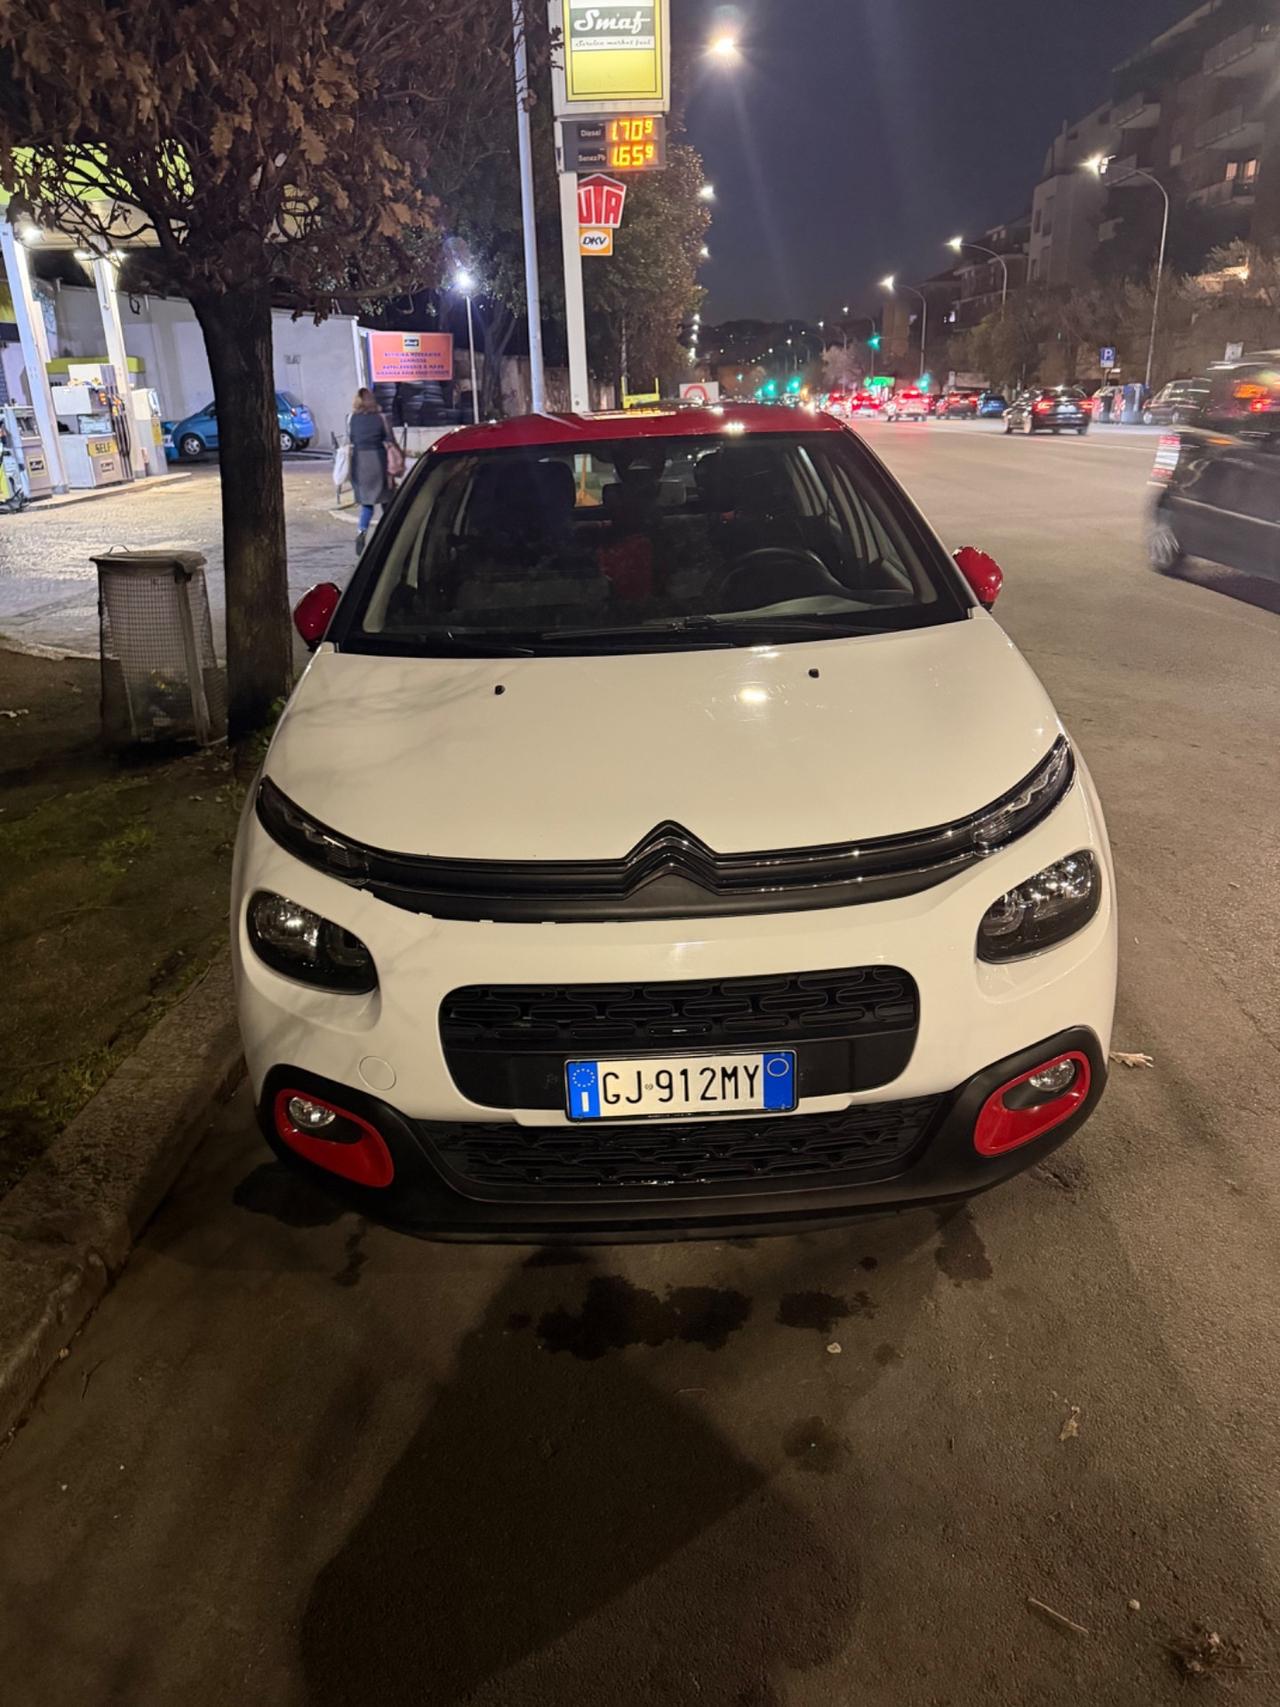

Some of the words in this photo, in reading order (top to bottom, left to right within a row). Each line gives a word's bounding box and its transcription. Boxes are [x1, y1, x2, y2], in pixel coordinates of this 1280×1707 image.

[578, 178, 624, 224] UTA
[582, 236, 608, 245] DKV
[1104, 348, 1113, 360] P
[95, 441, 113, 455] SELF
